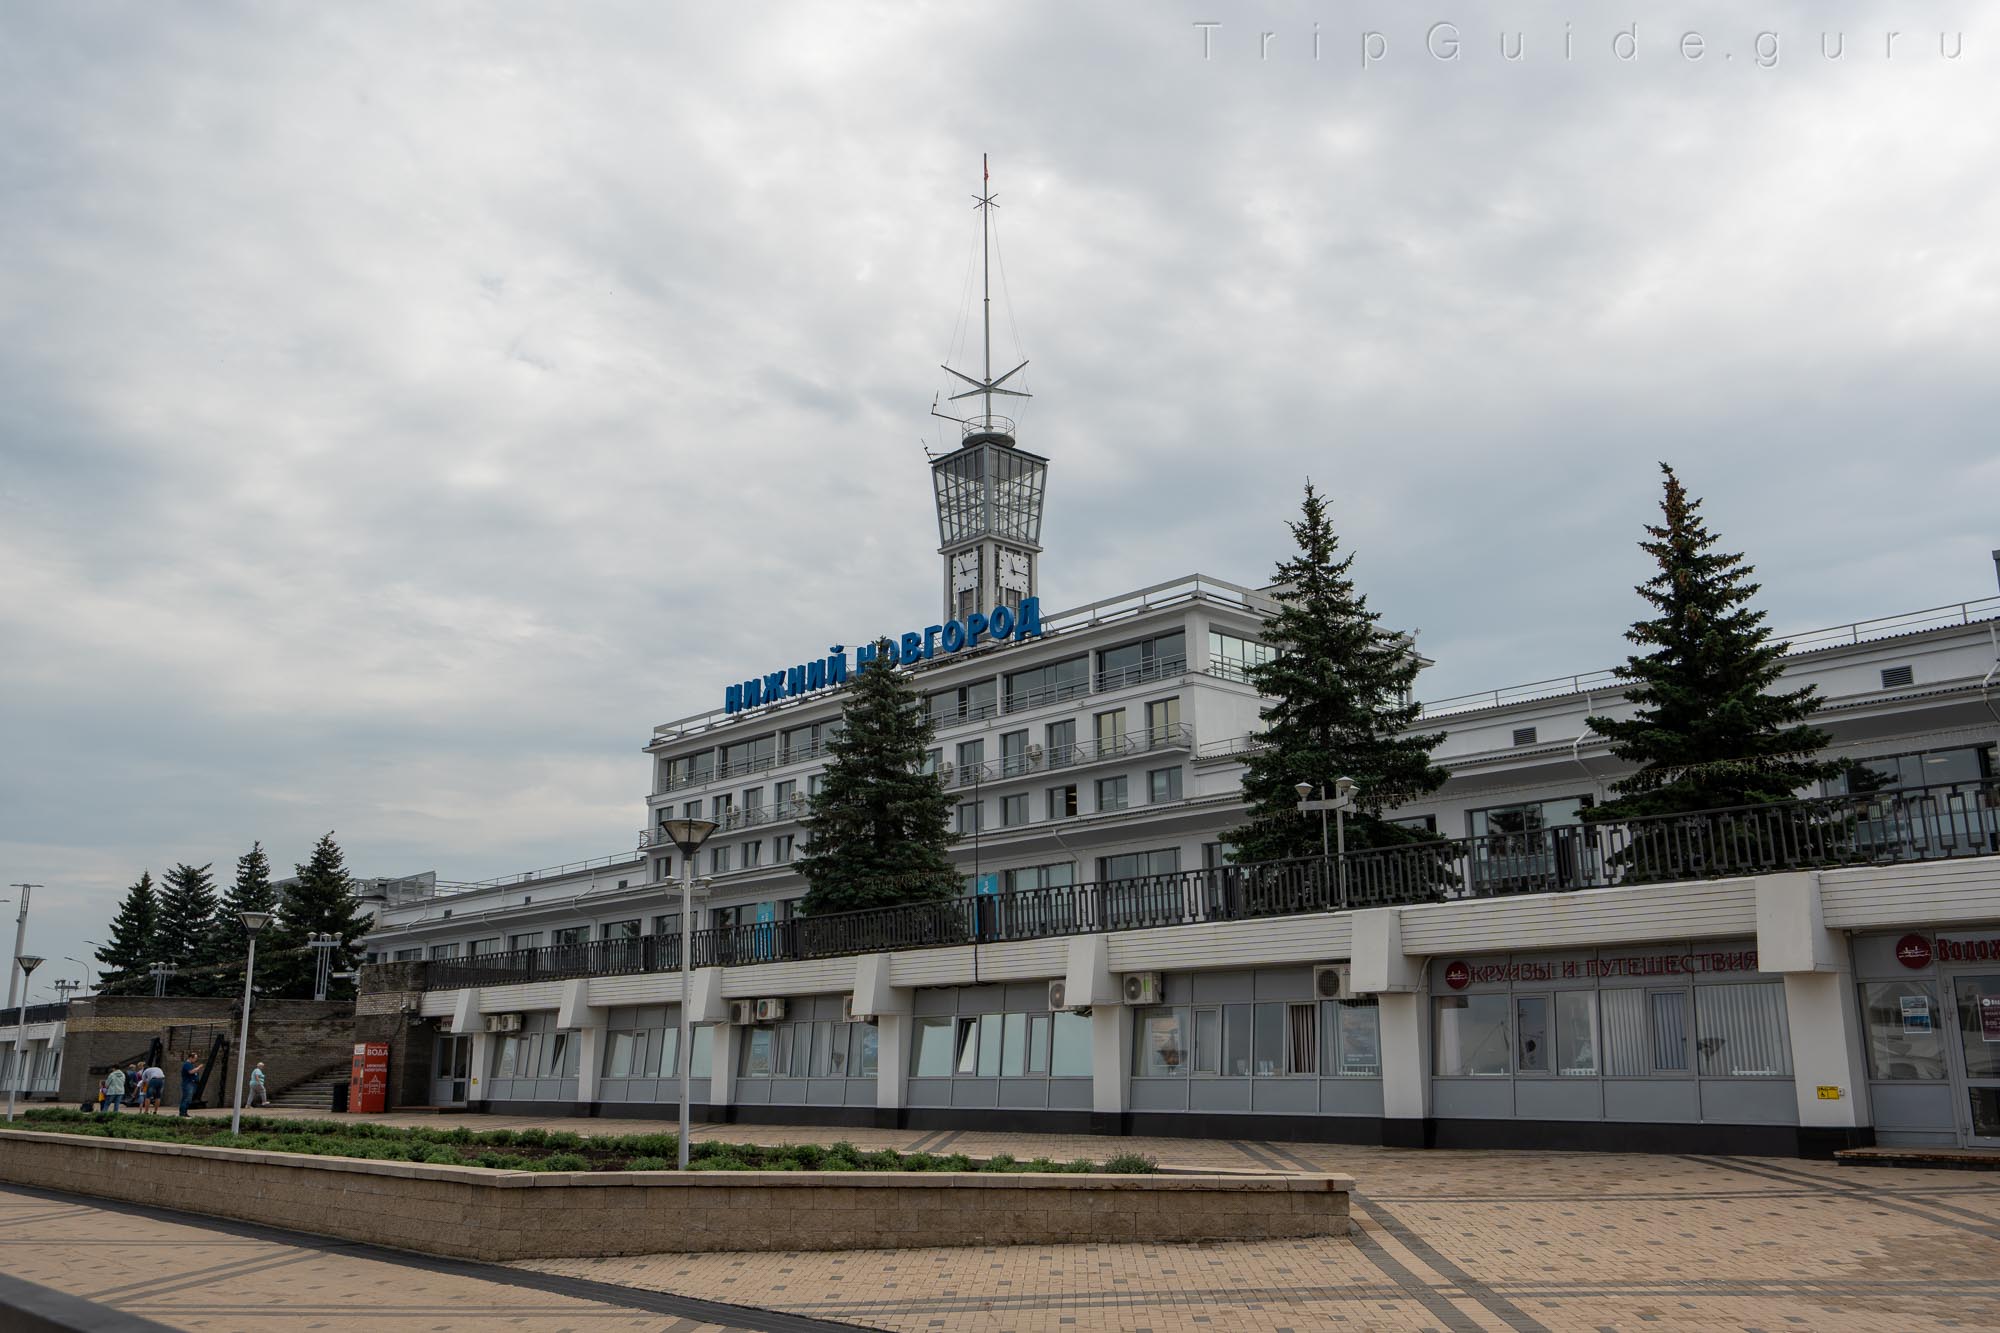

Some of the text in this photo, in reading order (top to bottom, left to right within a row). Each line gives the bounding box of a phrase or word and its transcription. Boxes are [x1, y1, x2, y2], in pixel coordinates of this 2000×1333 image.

[725, 644, 847, 714] НИЖНИЙ
[1471, 951, 1758, 983] КРУИЗЫ И ПУТЕШЕСТВИЯ
[367, 1048, 388, 1056] ВОДА
